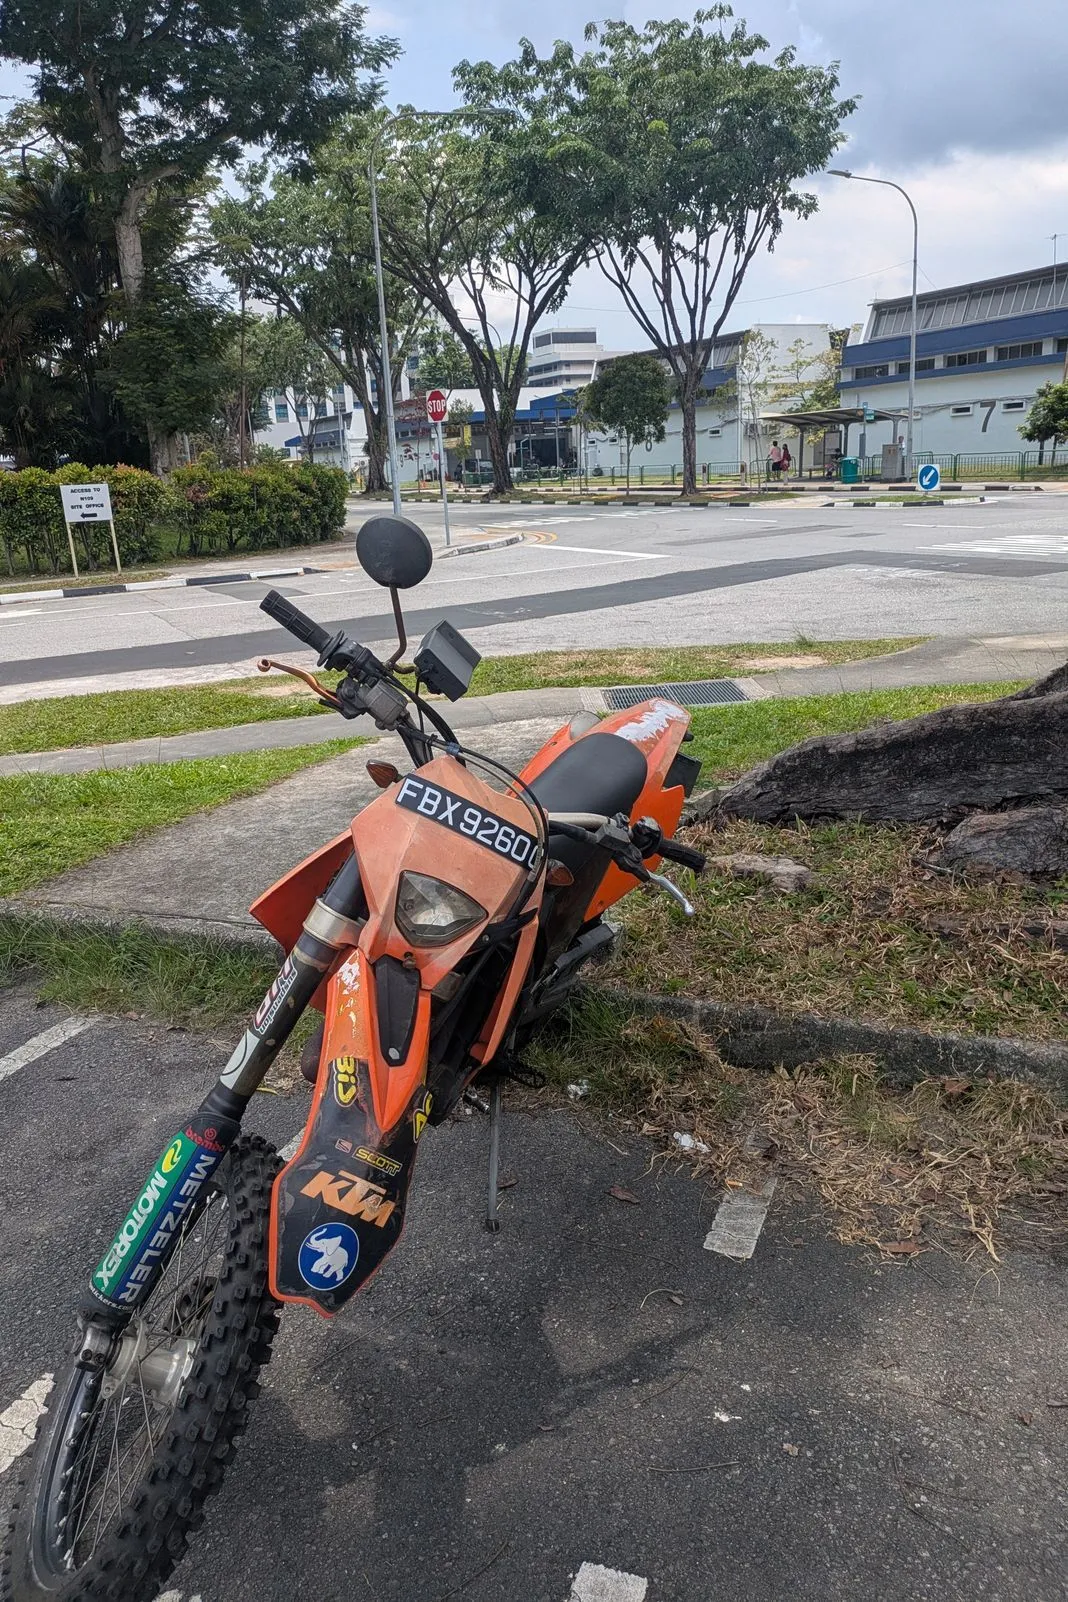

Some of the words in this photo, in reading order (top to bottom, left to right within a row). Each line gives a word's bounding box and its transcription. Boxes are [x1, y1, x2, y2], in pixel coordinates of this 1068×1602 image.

[427, 399, 447, 414] STOP
[979, 401, 997, 433] 7
[185, 1124, 226, 1152] brembo
[355, 1148, 400, 1174] SCOTT
[300, 1169, 396, 1229] KTM
[96, 1170, 168, 1289] MOTOREX
[119, 1154, 216, 1303] METZELER
